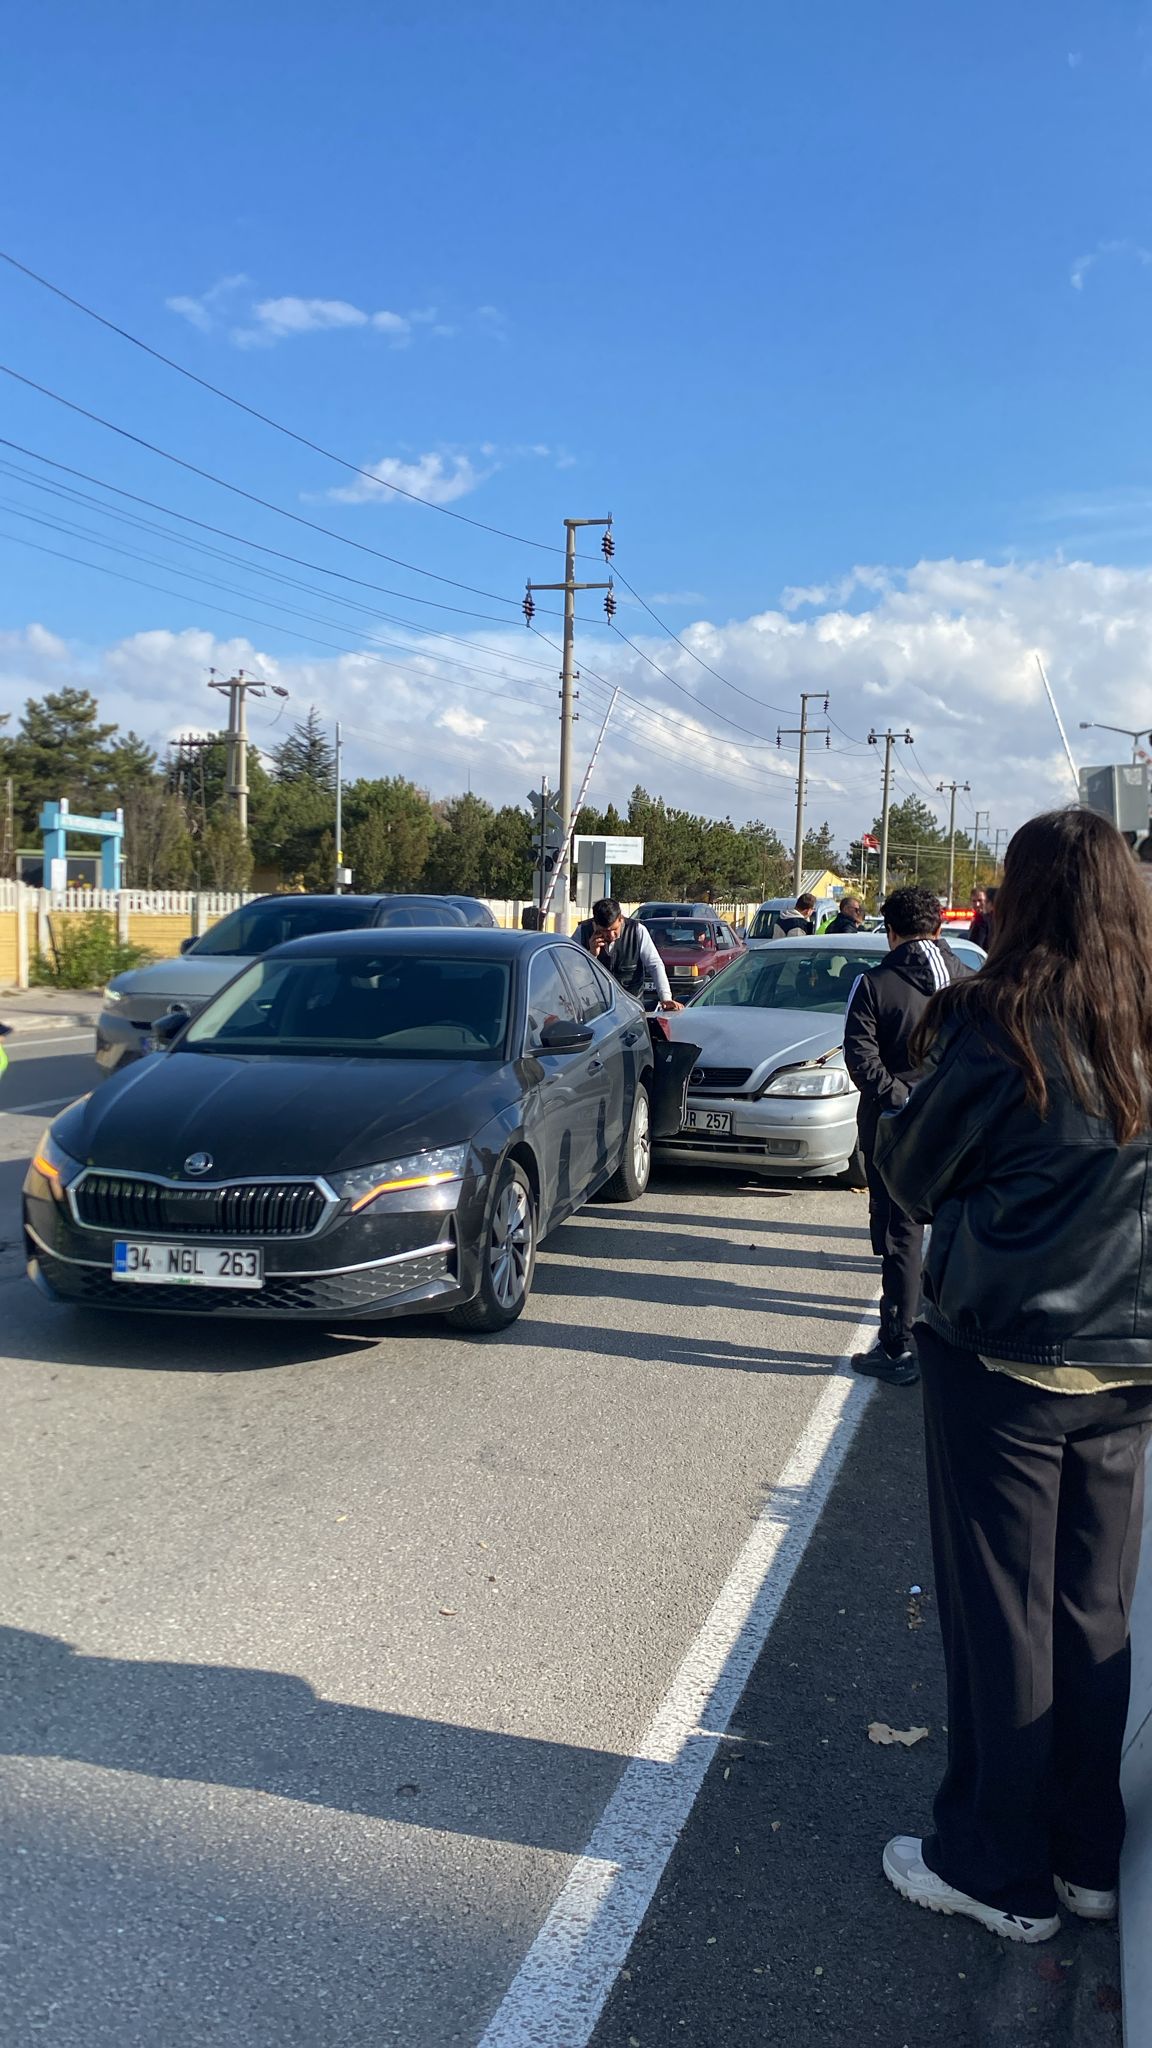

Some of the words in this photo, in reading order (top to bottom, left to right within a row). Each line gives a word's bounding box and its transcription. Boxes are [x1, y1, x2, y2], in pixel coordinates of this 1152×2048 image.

[706, 1113, 728, 1129] 257
[128, 1247, 151, 1271] 34
[168, 1248, 203, 1274] NGL
[219, 1251, 257, 1277] 263
